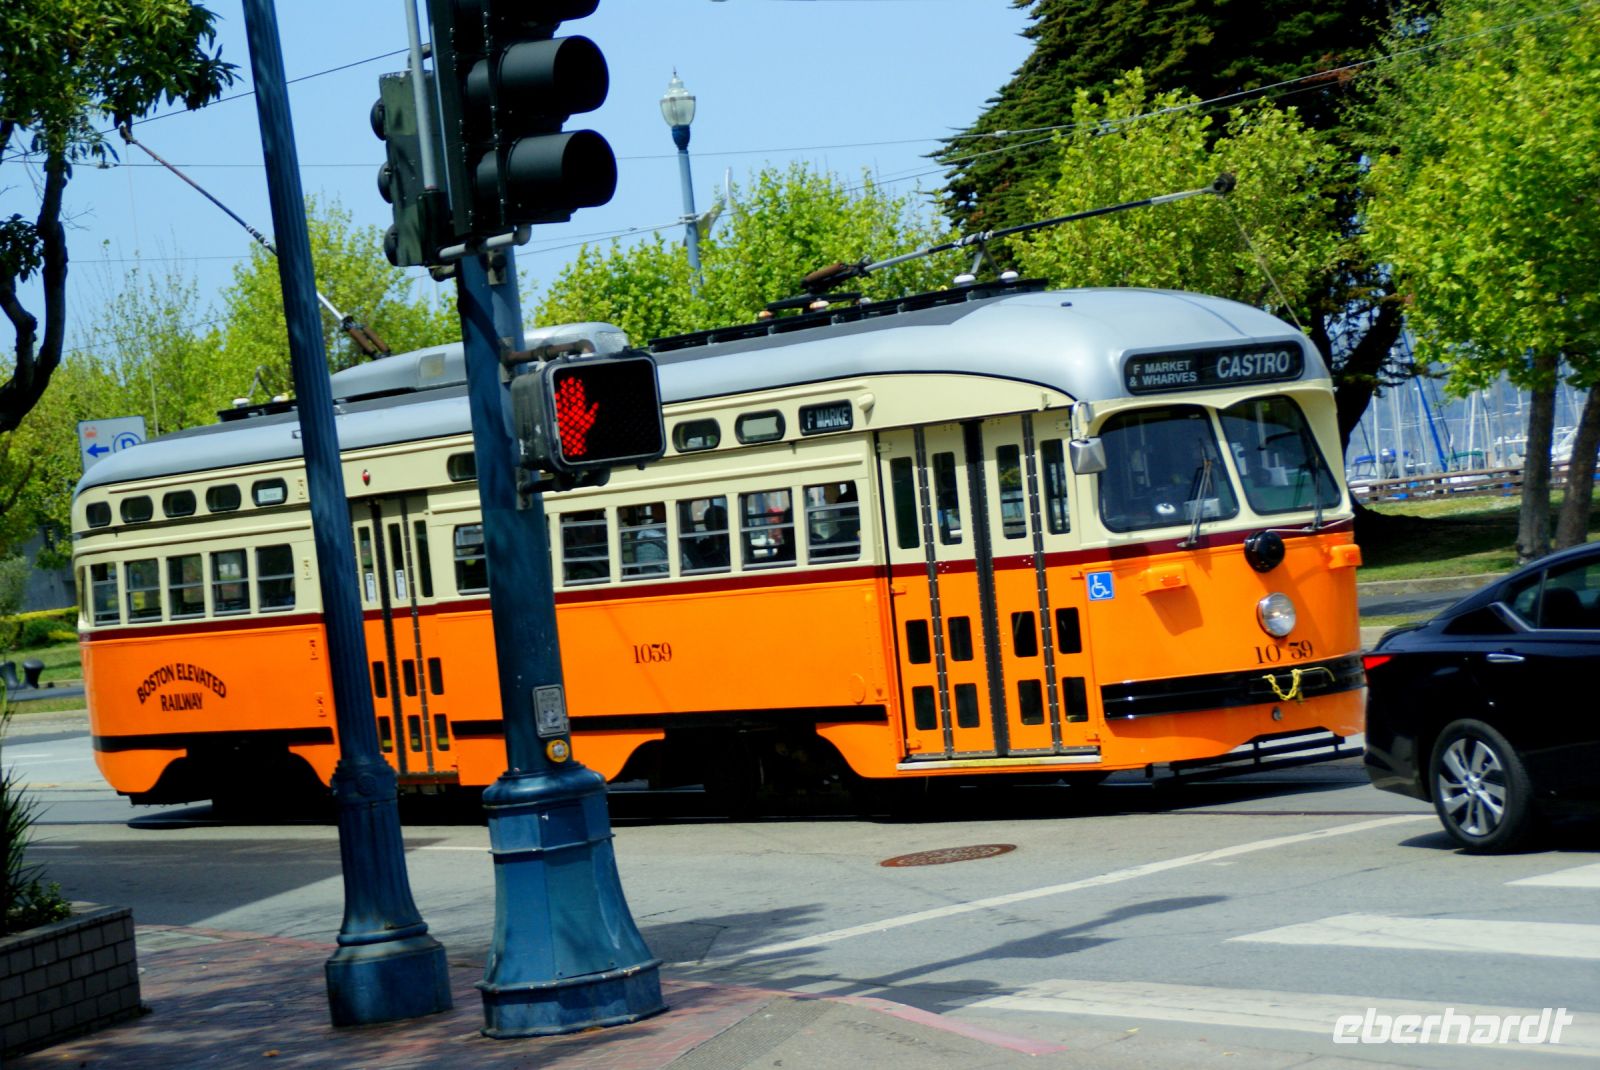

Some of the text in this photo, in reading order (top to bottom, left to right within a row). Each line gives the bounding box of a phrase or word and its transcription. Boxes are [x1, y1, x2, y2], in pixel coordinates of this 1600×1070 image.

[1133, 360, 1191, 375] F MARKET
[1216, 351, 1290, 379] CASTRO
[1129, 371, 1198, 387] & WHARVES
[807, 410, 814, 429] F
[633, 641, 673, 664] 1059
[136, 662, 227, 705] BOSTON ELEVATED
[160, 692, 203, 712] RAILWAY
